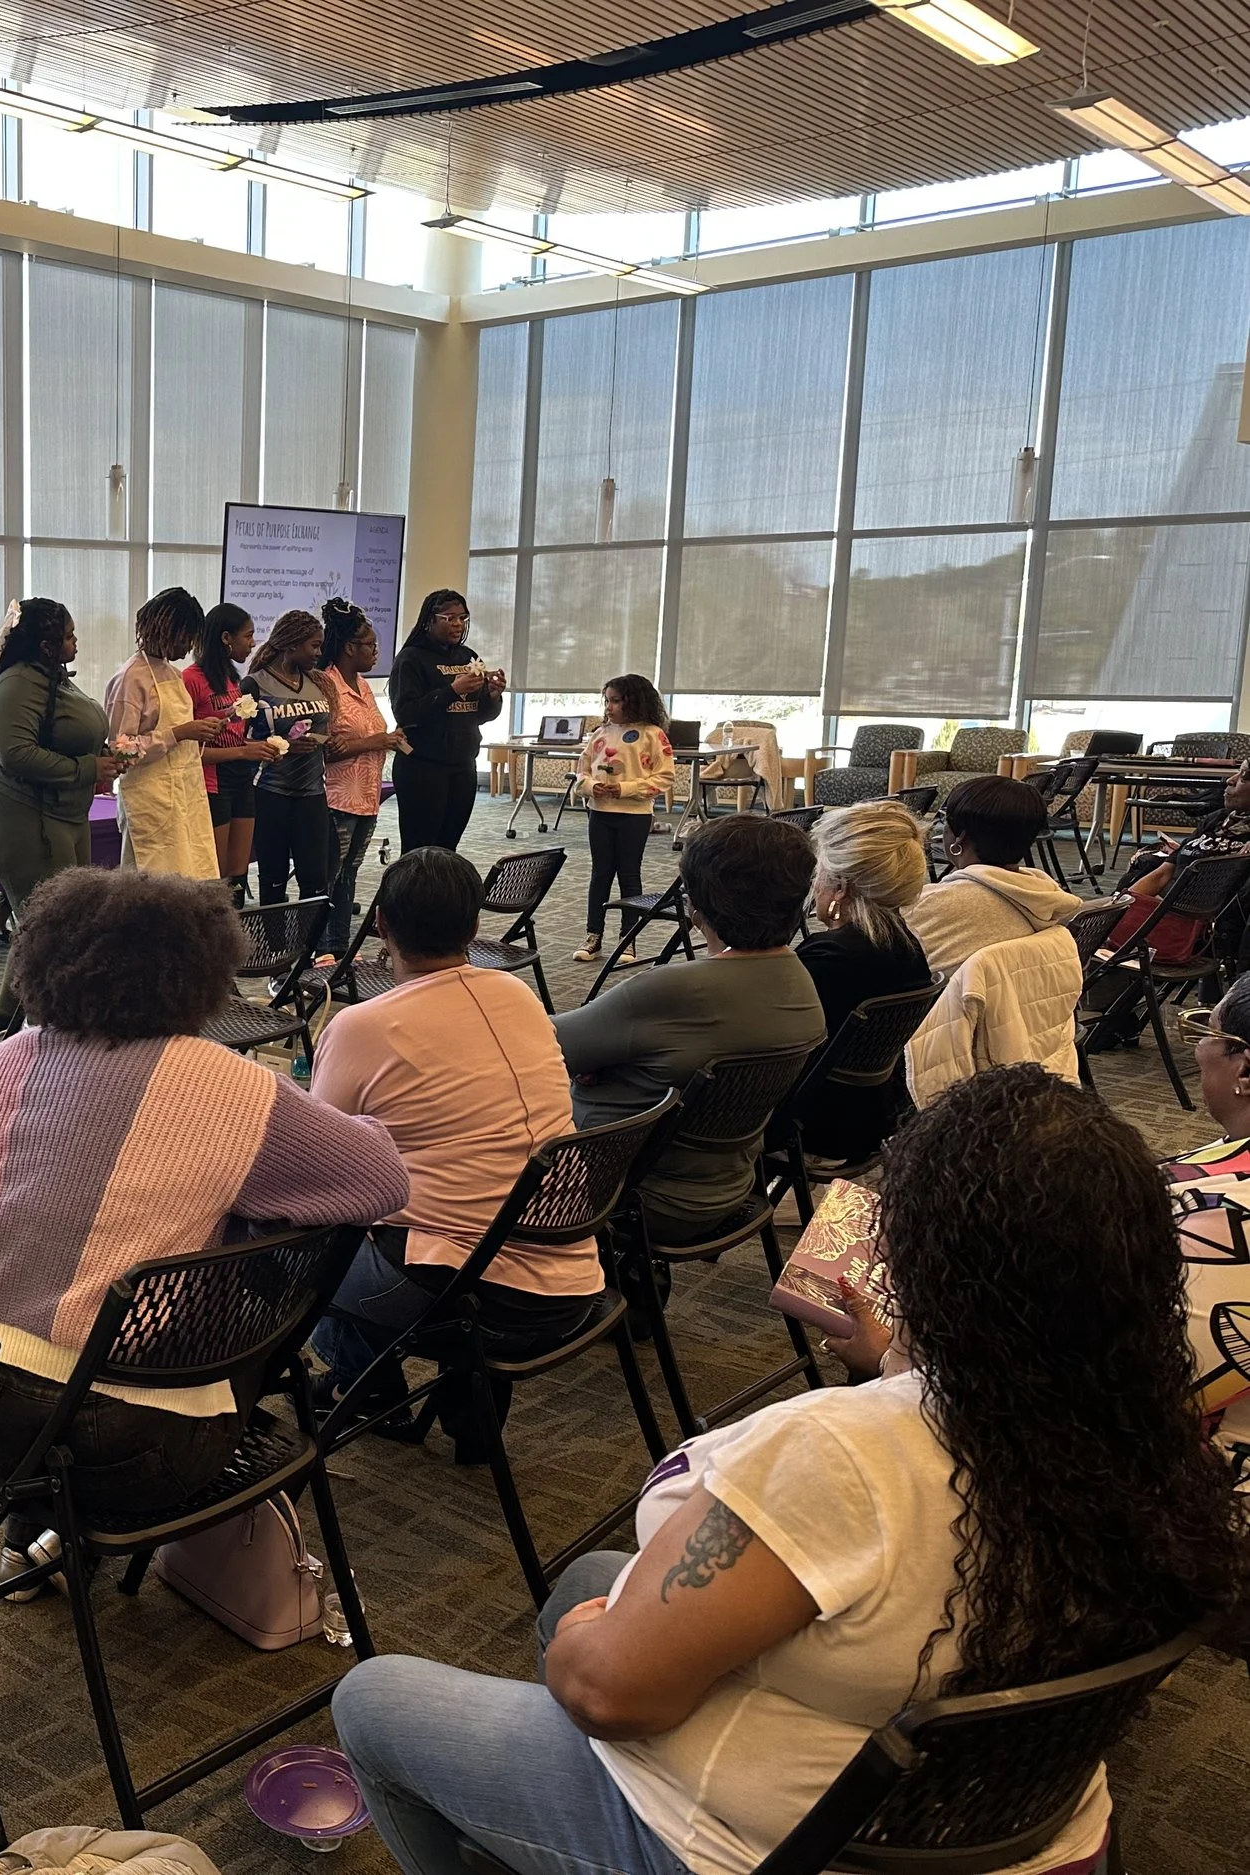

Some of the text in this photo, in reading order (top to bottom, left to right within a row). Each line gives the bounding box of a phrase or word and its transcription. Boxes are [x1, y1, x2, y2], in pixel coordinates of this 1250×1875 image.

[231, 565, 245, 574] Each
[245, 566, 262, 574] flower
[285, 568, 307, 576] message
[307, 567, 314, 575] of
